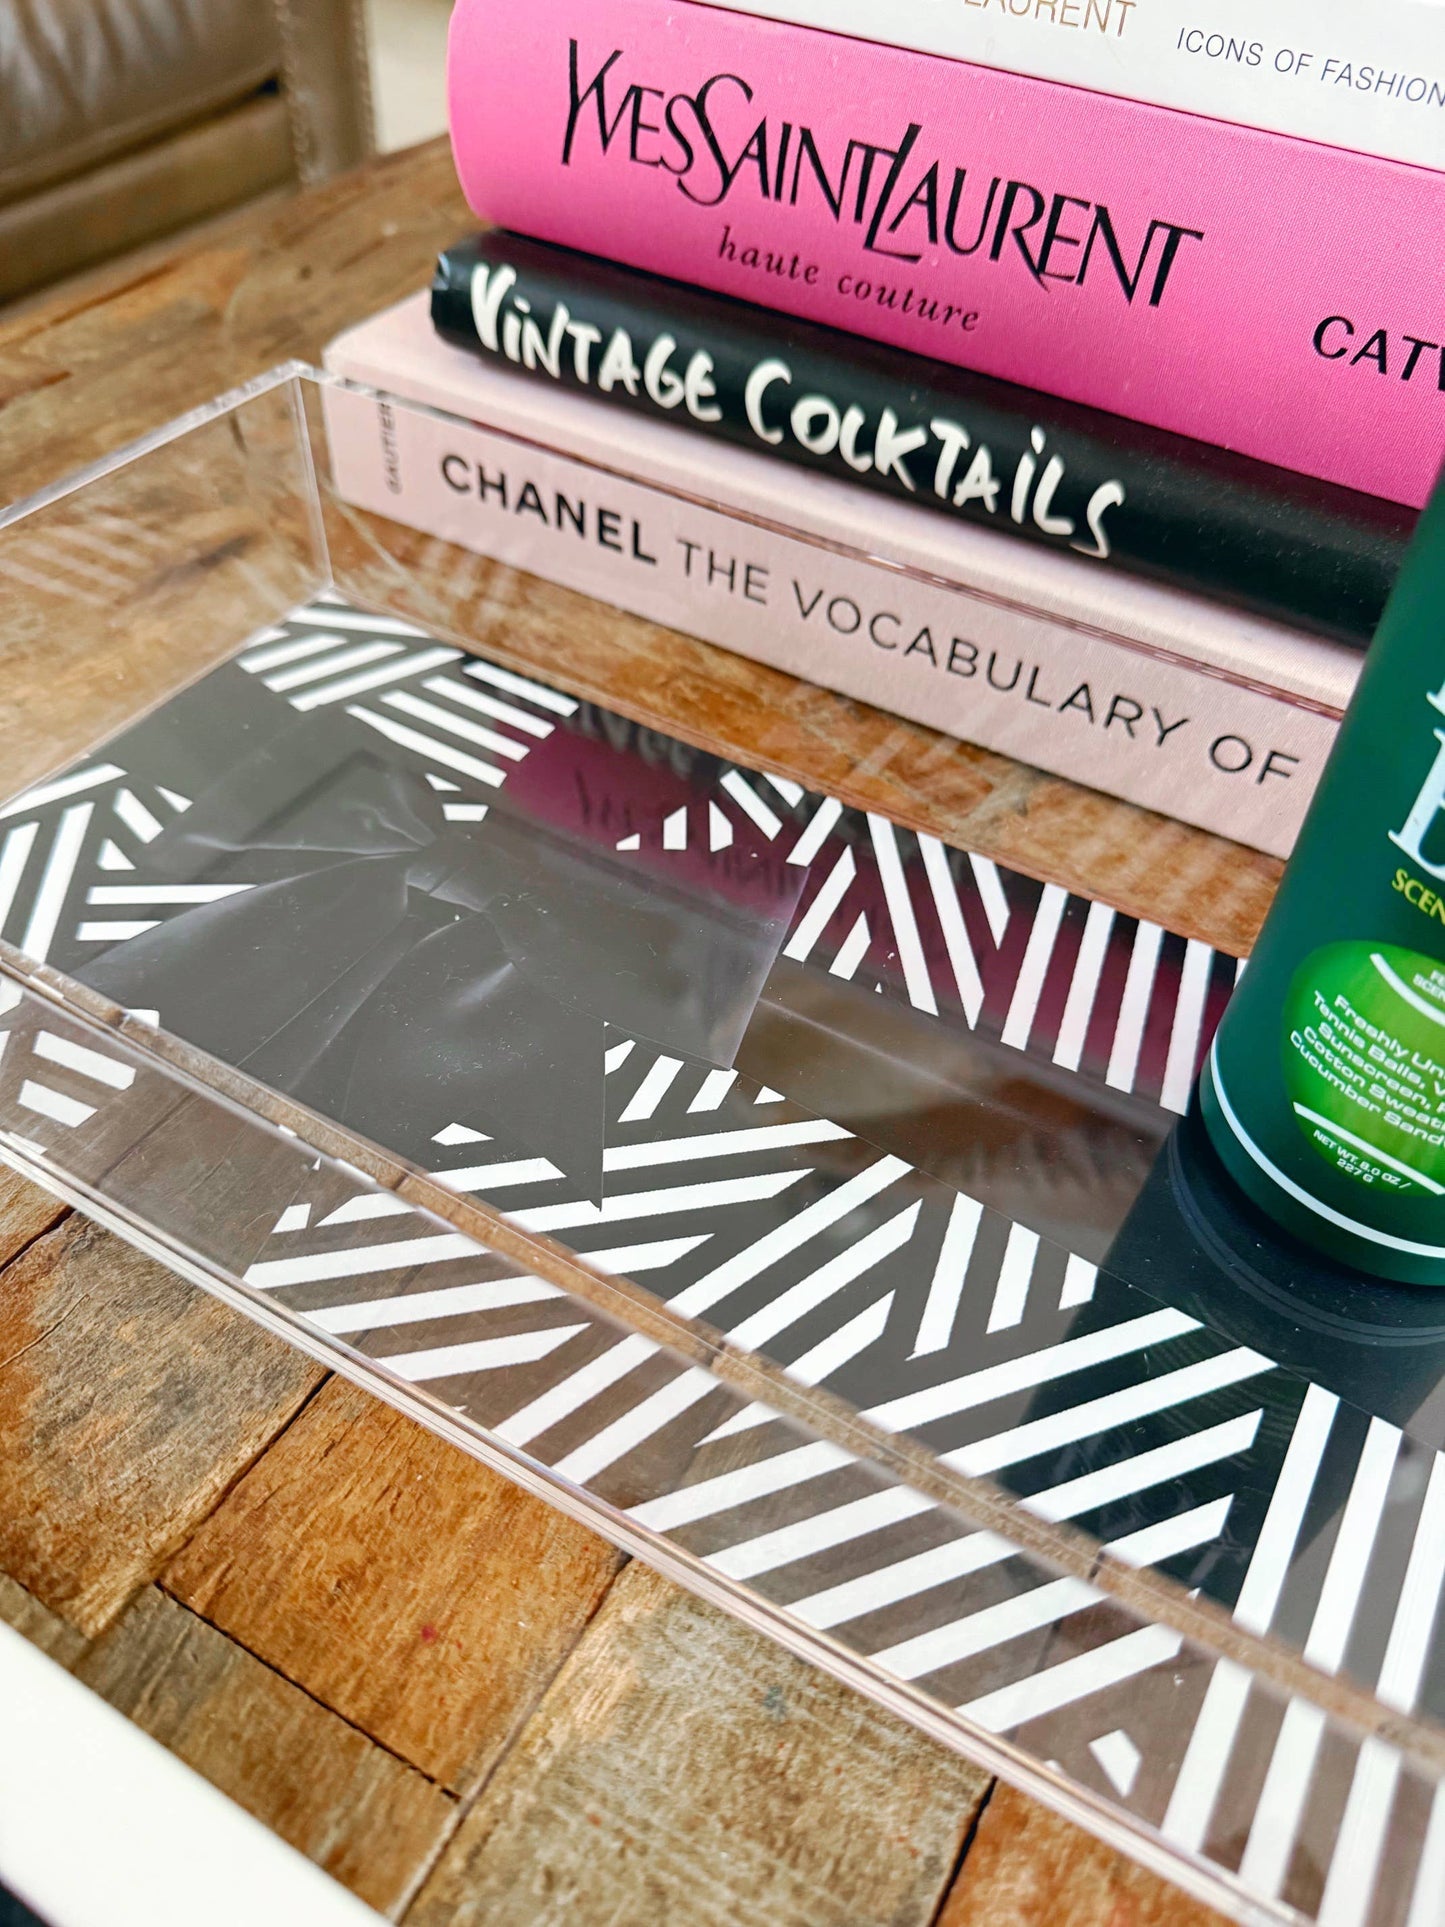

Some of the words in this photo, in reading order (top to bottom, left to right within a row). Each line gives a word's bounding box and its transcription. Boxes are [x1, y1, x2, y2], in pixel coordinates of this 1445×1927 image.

[964, 0, 1137, 37] RENT
[1176, 27, 1263, 67] ICONS
[1273, 48, 1314, 77] OF
[717, 225, 820, 286] haute
[837, 272, 980, 333] couture
[1312, 315, 1445, 392] CAT
[441, 454, 657, 565] CHANEL
[677, 538, 769, 606] THE
[791, 578, 1189, 748] VOCABULARY
[1208, 735, 1300, 786] OF
[1303, 1026, 1365, 1088] Cotton
[1314, 990, 1366, 1049] Tennis
[1368, 1044, 1425, 1090] Balls,
[1318, 1022, 1432, 1110] Sunscreen,
[1334, 994, 1409, 1058] Freshly
[1411, 1052, 1445, 1080] Un
[1290, 1030, 1382, 1113] Cucumber
[1383, 1110, 1445, 1148] Sand
[1313, 1129, 1337, 1149] NET
[1337, 1146, 1359, 1165] WT.
[1360, 1161, 1381, 1176] 8.0
[1337, 1158, 1362, 1176] 227
[1362, 1173, 1374, 1183] G
